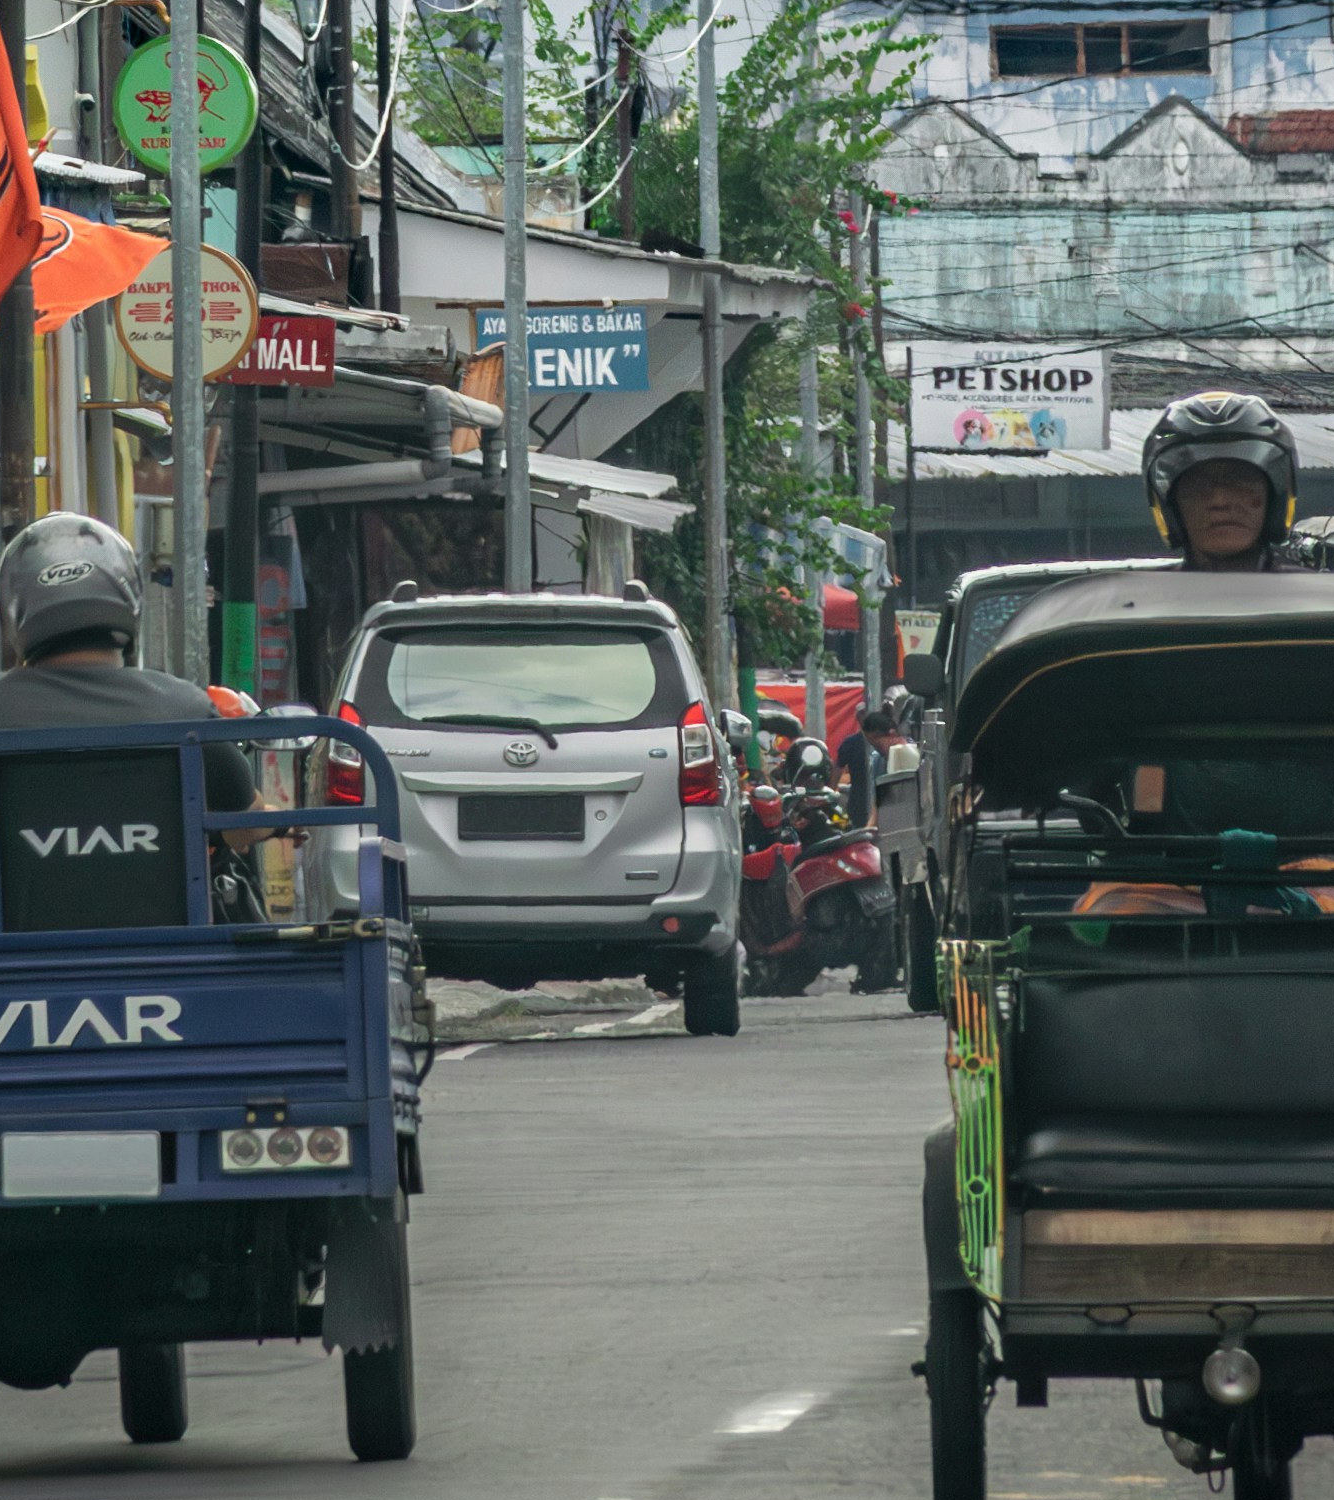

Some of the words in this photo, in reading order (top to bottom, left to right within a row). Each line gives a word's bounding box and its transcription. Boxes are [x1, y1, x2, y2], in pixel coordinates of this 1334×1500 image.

[482, 317, 506, 336] AYA
[582, 314, 594, 333] &
[596, 312, 642, 333] BAKAR
[257, 337, 327, 373] MALL
[19, 823, 160, 857] VIAR
